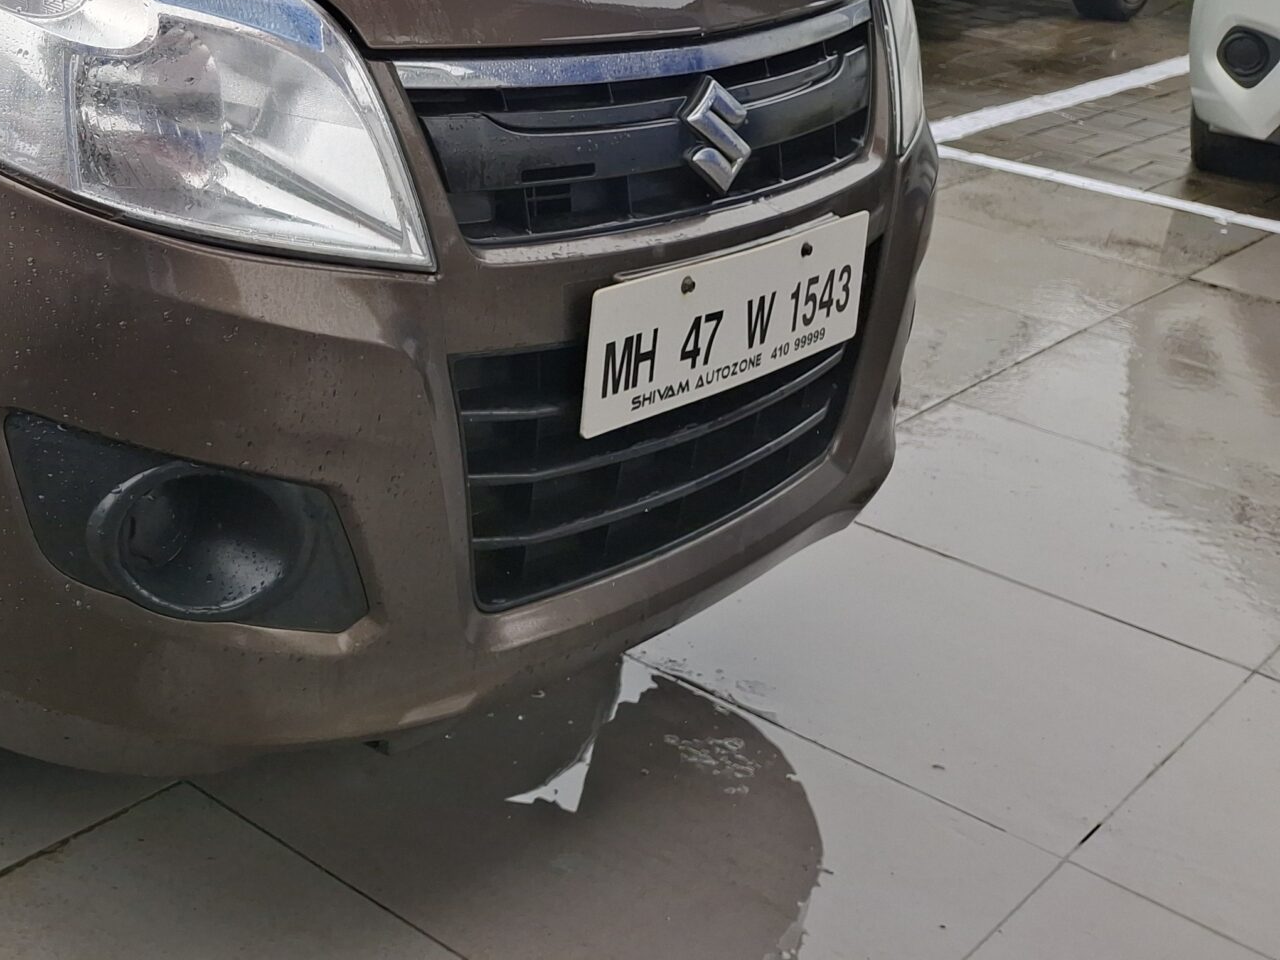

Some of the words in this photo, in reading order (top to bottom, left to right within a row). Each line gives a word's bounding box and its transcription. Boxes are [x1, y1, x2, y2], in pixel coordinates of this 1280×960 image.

[601, 328, 658, 399] MH
[680, 310, 724, 371] 47
[747, 291, 777, 350] W
[790, 264, 851, 333] 1543
[631, 381, 690, 411] SHIVAM
[695, 353, 762, 390] AUTOZONE
[770, 340, 789, 361] 410
[794, 327, 826, 354] 99999
